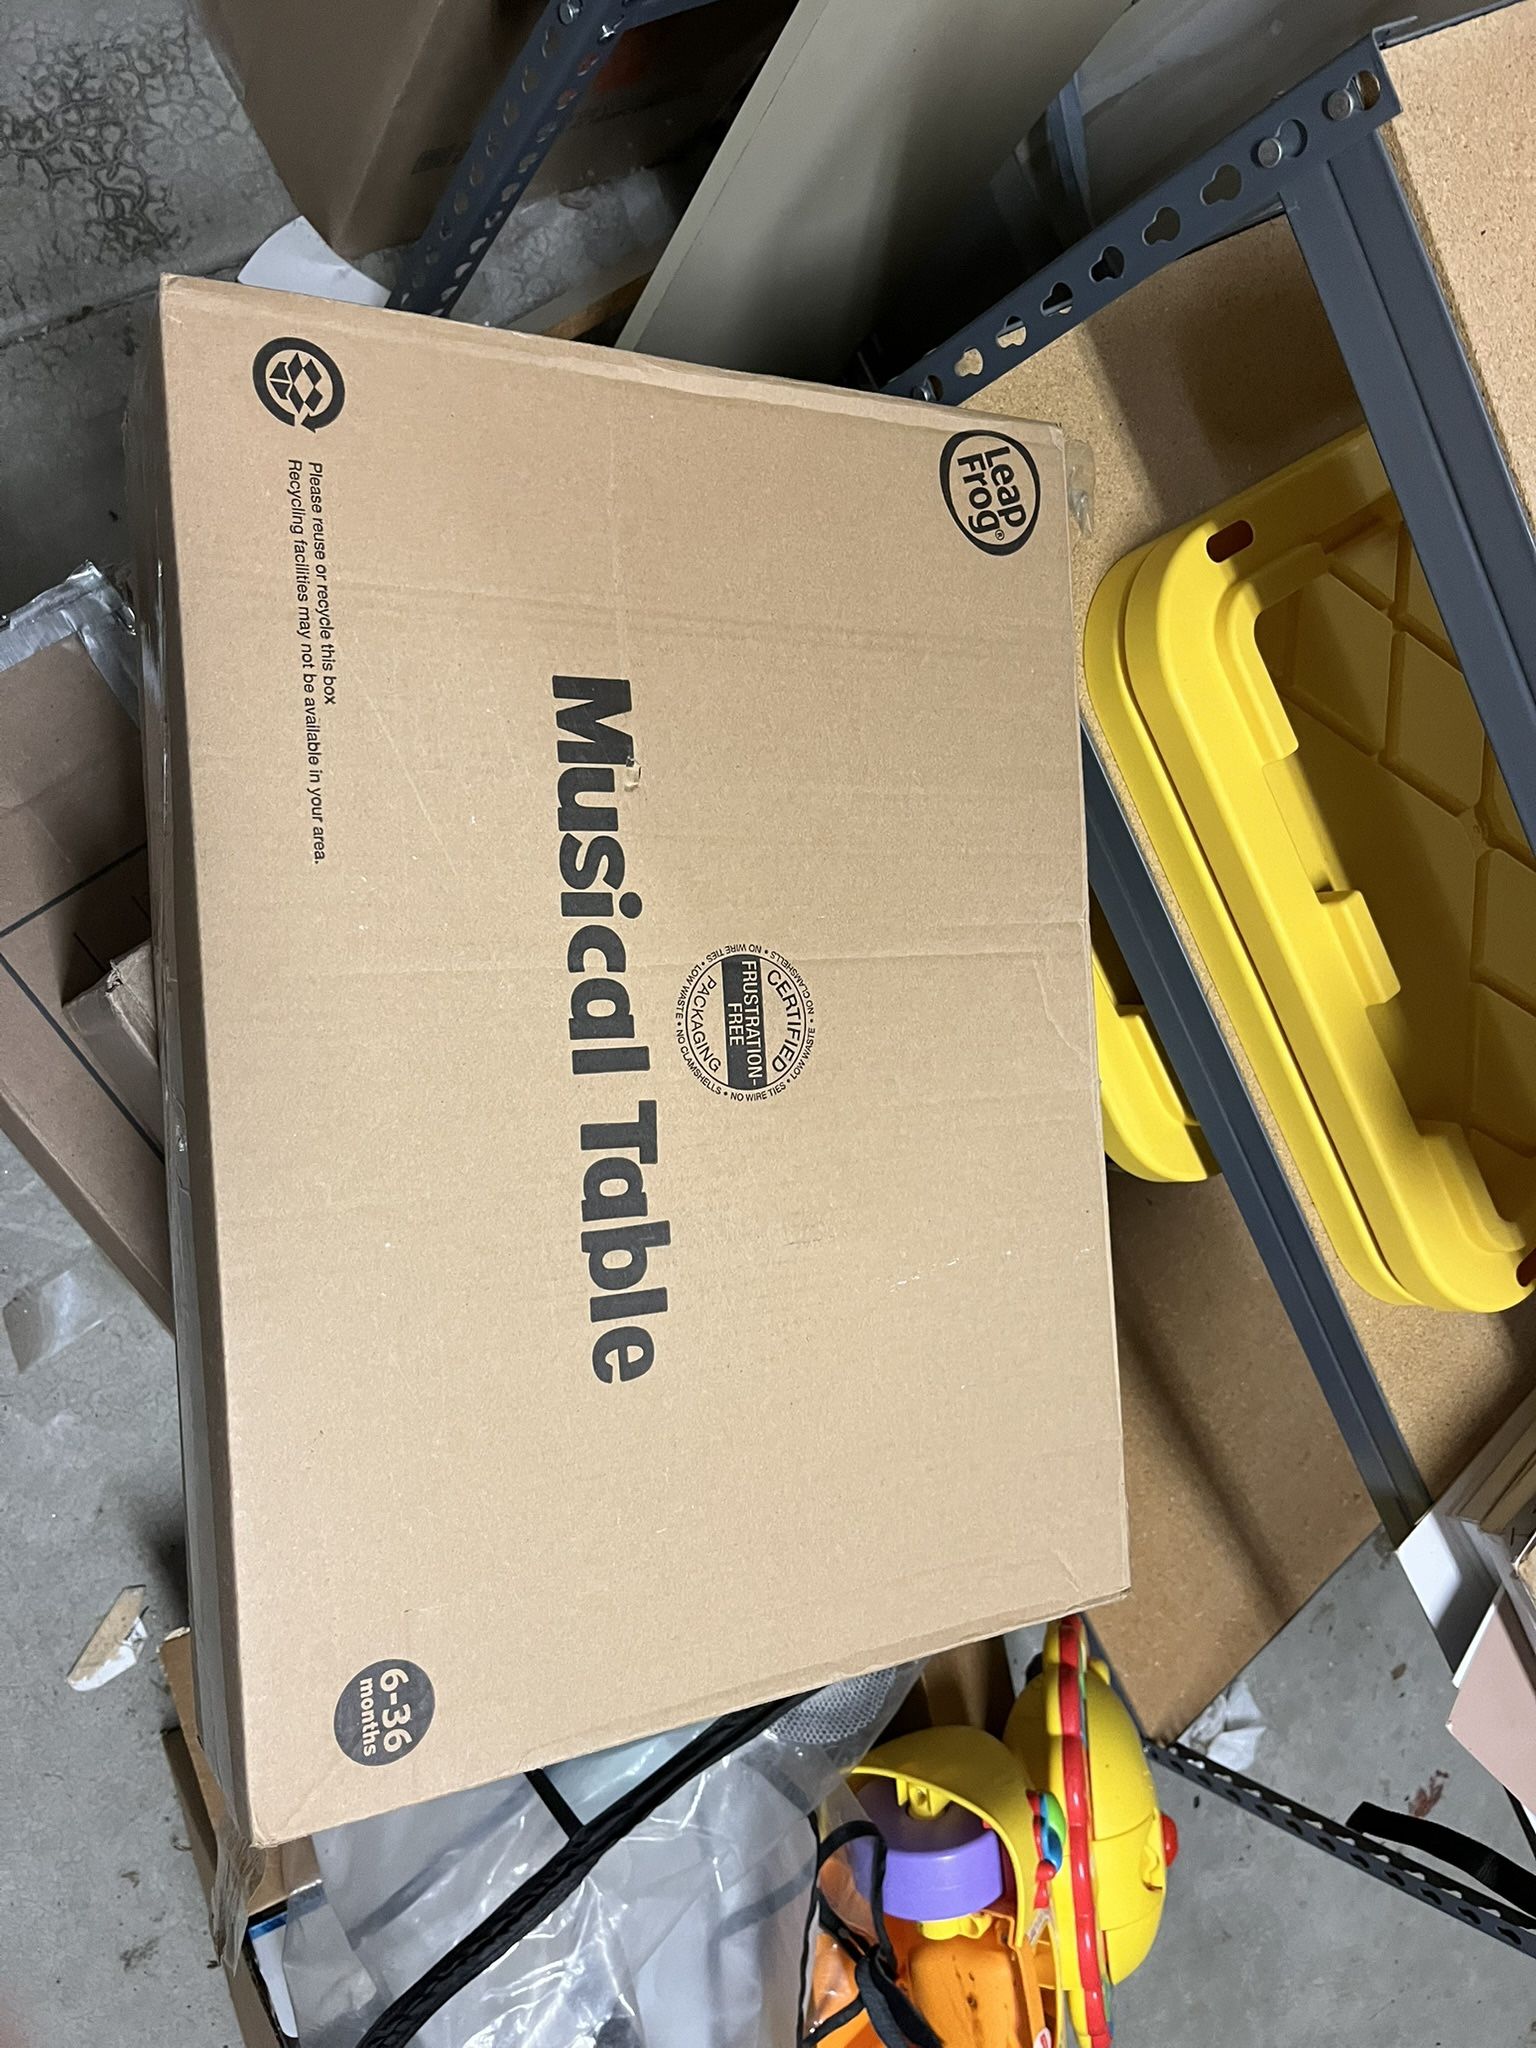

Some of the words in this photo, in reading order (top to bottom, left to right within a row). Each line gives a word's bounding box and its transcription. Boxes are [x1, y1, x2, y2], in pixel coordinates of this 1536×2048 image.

[287, 459, 306, 535] Recycling
[308, 461, 323, 513] Please
[957, 453, 1000, 534] Frog
[984, 446, 1027, 527] Leap
[312, 517, 325, 560] reuse
[294, 539, 310, 602] facilities
[315, 564, 327, 581] or
[297, 606, 311, 639] may
[315, 584, 334, 640] recycle
[301, 643, 315, 669] not
[321, 643, 336, 671] this
[303, 673, 317, 693] be
[323, 676, 336, 704] box
[305, 697, 322, 765] available
[309, 770, 323, 783] in
[306, 787, 323, 822] your
[313, 826, 325, 864] area.
[552, 675, 650, 1075] Musical
[705, 948, 723, 963] TIES
[724, 943, 747, 954] WIRE
[748, 943, 762, 953] NO
[686, 964, 702, 985] LOW
[770, 950, 811, 999] CLAMSHELLS
[675, 985, 690, 1019] WASTE
[741, 960, 763, 1086] FRUSTRATION-
[767, 969, 801, 1072] CERTIFIED
[806, 1000, 815, 1015] NO
[676, 1029, 686, 1044] NO
[690, 975, 721, 1073] PACKAGING
[728, 1003, 744, 1046] FREE
[680, 1045, 722, 1095] CLAMSHELLS
[790, 1060, 805, 1080] LOW
[802, 1027, 816, 1060] WASTE
[730, 1092, 744, 1101] NO
[746, 1091, 767, 1101] WIRE
[769, 1082, 786, 1096] TIES
[580, 1100, 671, 1384] Table
[360, 1678, 380, 1757] months
[380, 1668, 413, 1752] 6-36
